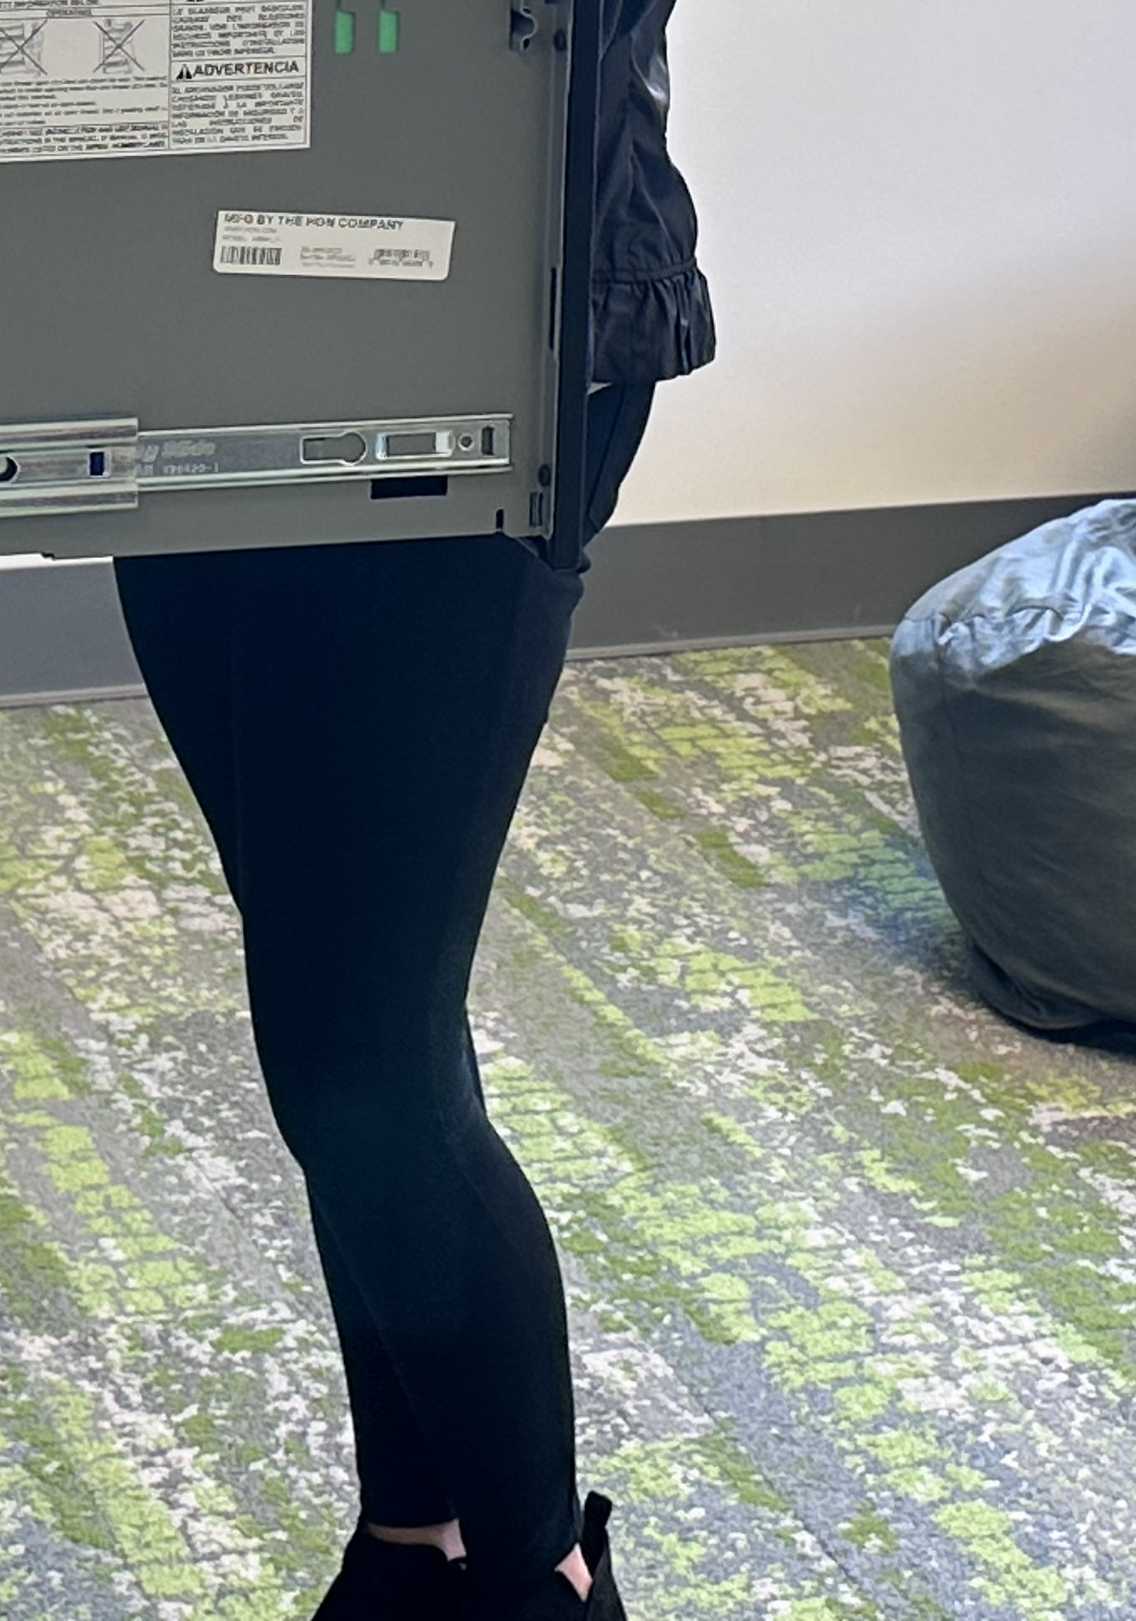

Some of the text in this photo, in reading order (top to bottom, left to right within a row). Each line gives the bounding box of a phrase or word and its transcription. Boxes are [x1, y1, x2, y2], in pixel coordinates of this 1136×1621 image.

[192, 60, 299, 77] ADVERTENCIA
[256, 213, 273, 226] BY
[277, 214, 303, 227] THE
[306, 216, 335, 228] HON
[338, 217, 405, 230] COMPANY
